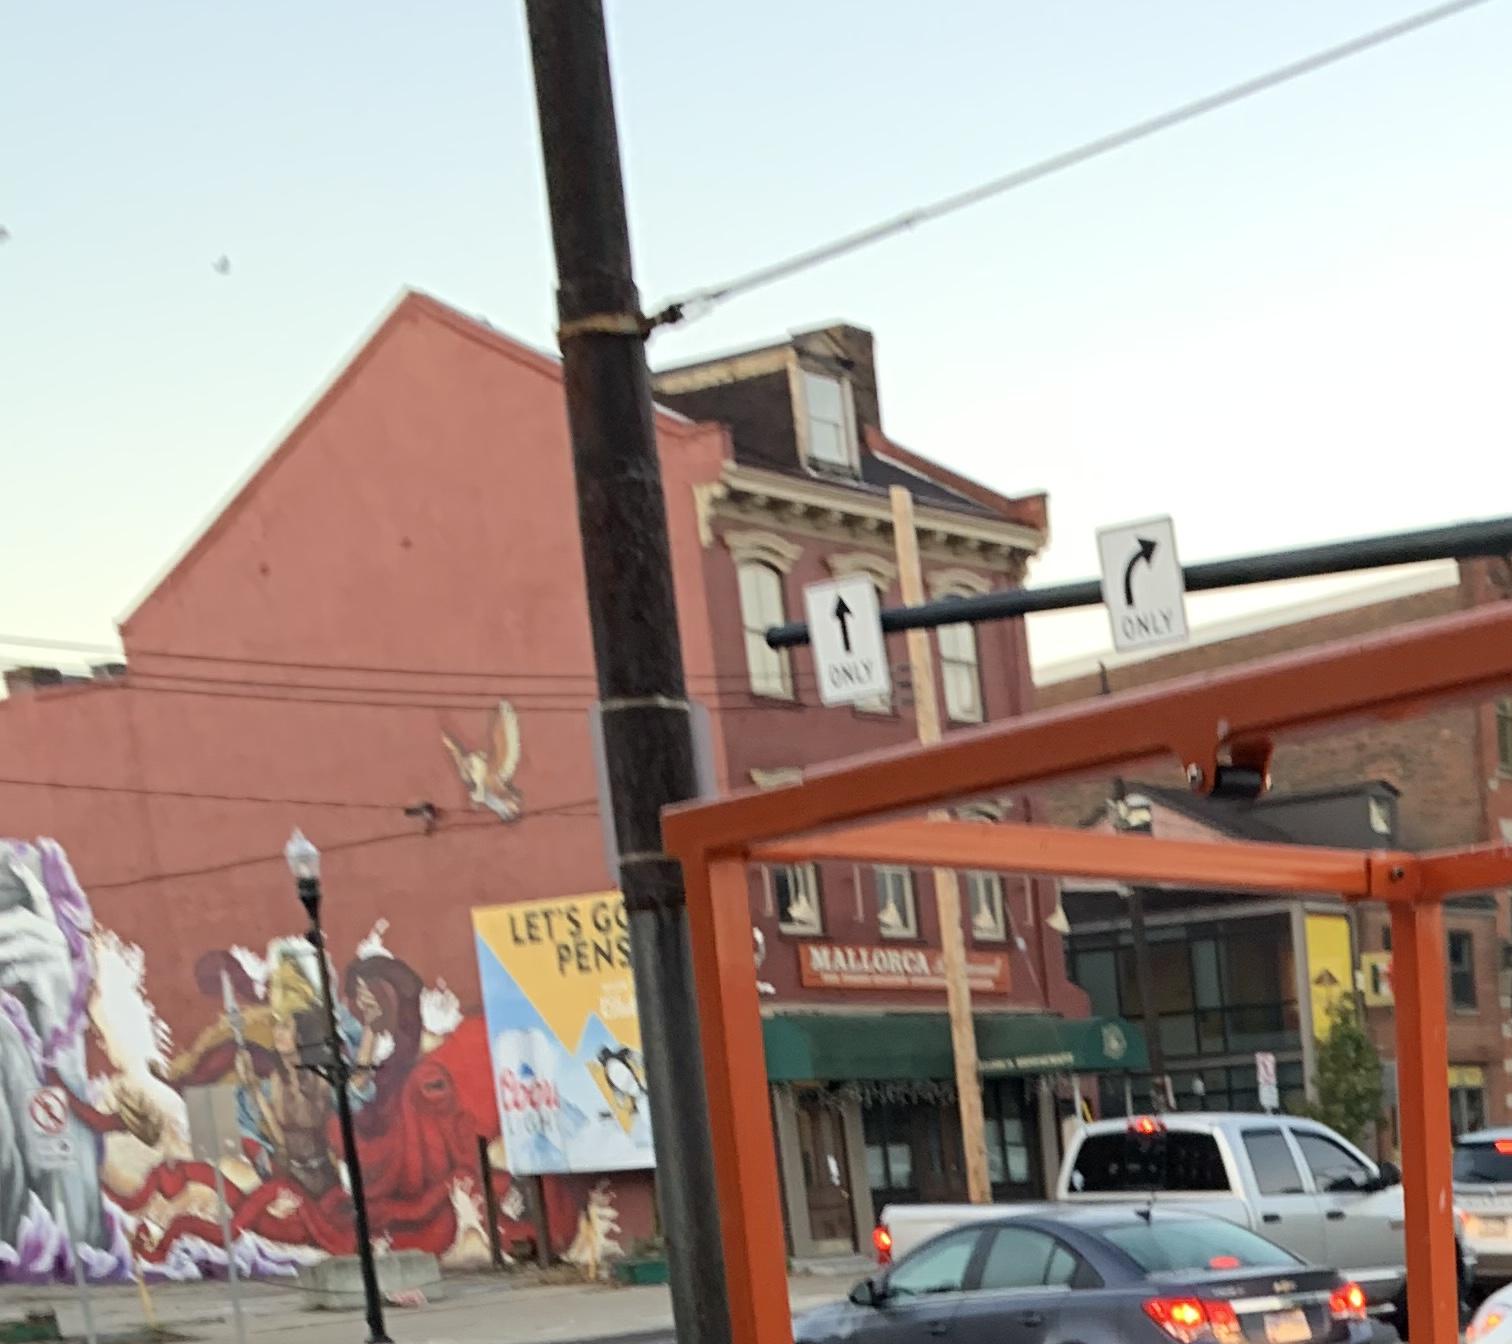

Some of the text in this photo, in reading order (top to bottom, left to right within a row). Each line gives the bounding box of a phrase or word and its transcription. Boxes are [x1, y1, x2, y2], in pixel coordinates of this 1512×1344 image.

[1123, 609, 1173, 639] ONLY
[828, 657, 874, 687] ONLY
[508, 903, 582, 946] LET'S
[556, 935, 633, 977] PENS
[809, 945, 931, 976] MALLORCA
